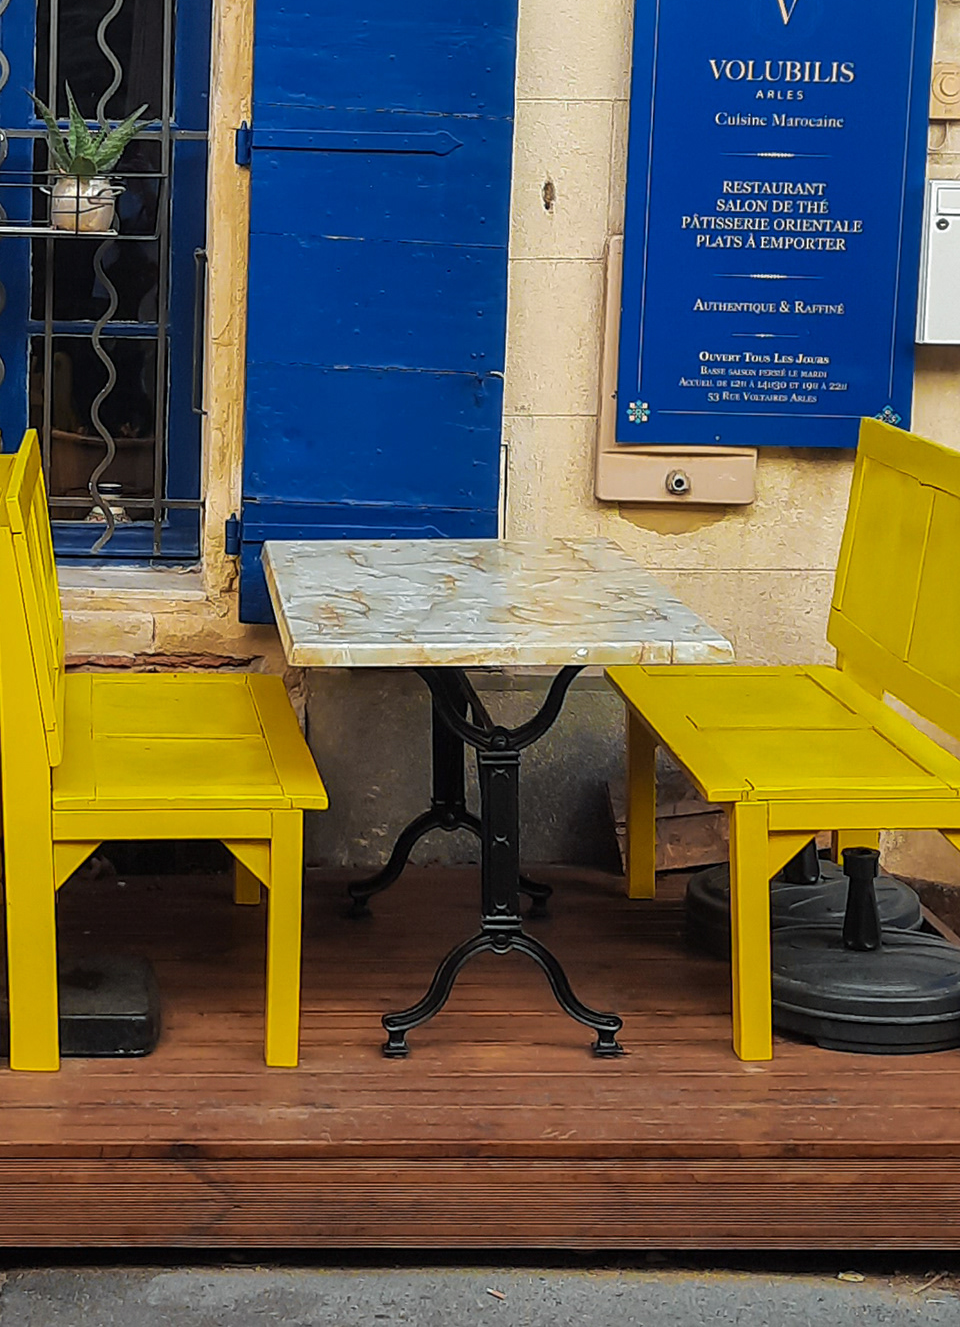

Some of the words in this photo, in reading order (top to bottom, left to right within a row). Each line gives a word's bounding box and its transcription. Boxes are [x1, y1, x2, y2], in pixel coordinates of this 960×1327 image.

[709, 59, 855, 83] VOLUBILIS
[755, 89, 804, 100] ARLES
[715, 111, 767, 126] Cuisine
[772, 113, 844, 128] Marocaine
[722, 180, 826, 195] RESTAURANT
[716, 199, 768, 213] SALON
[772, 200, 793, 213] DE
[797, 198, 829, 214] THÉ
[681, 214, 770, 230] PÂTISSERIE
[773, 218, 863, 233] ORIENTALE
[696, 234, 743, 248] PLATS
[745, 232, 756, 249] À
[760, 236, 846, 251] EMPORTER
[779, 301, 790, 314] &
